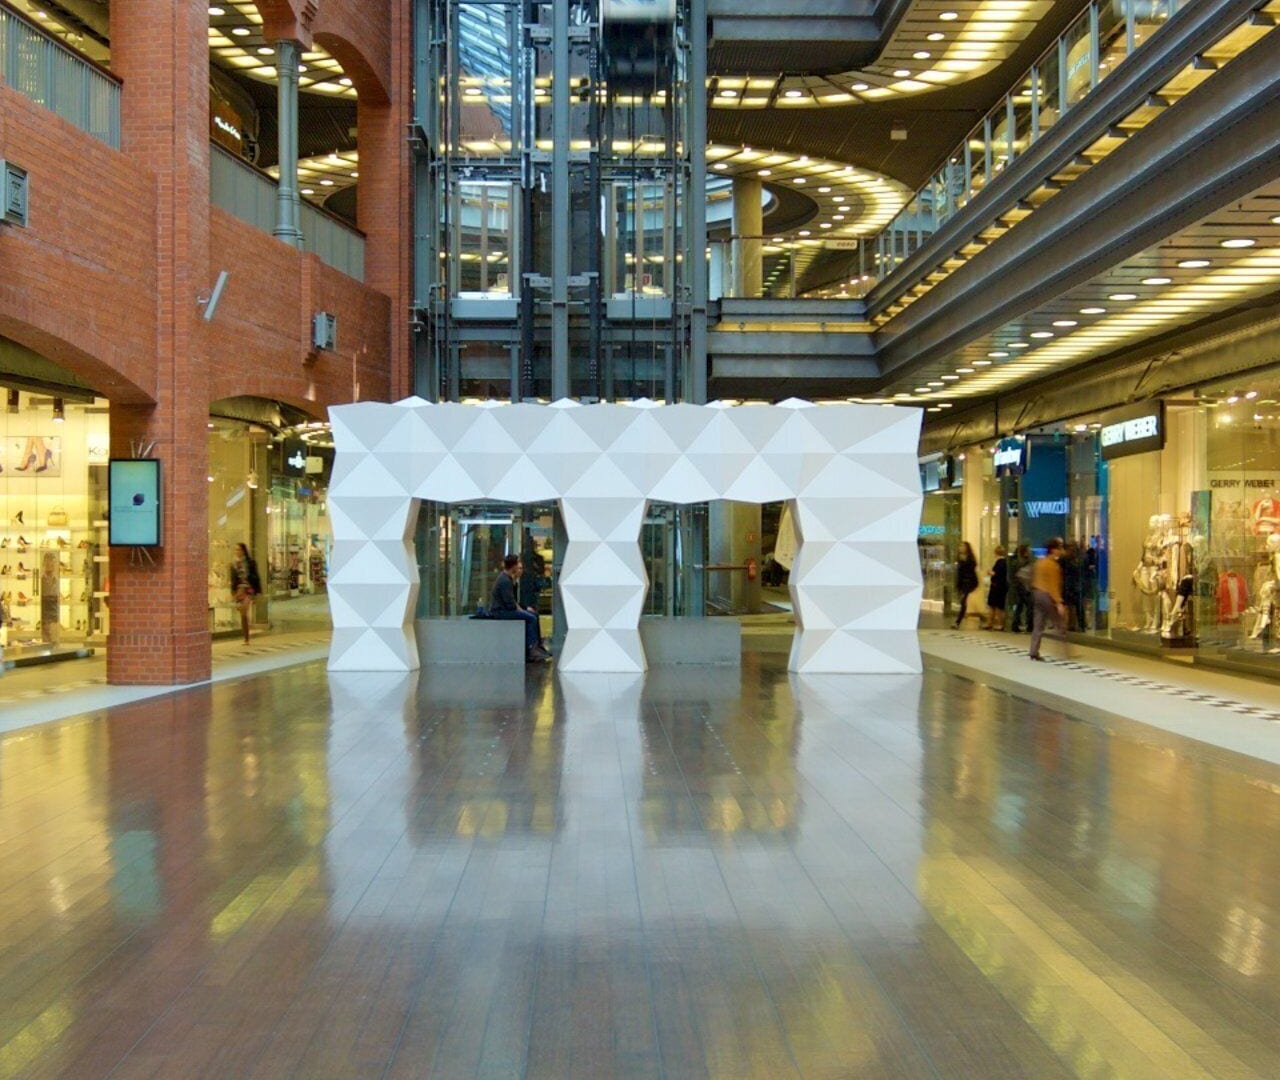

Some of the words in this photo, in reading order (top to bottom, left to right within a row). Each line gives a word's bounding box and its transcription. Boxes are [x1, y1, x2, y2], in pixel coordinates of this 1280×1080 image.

[1125, 414, 1159, 443] WEBER
[1210, 479, 1242, 488] GERRY
[1244, 479, 1275, 488] WEBER
